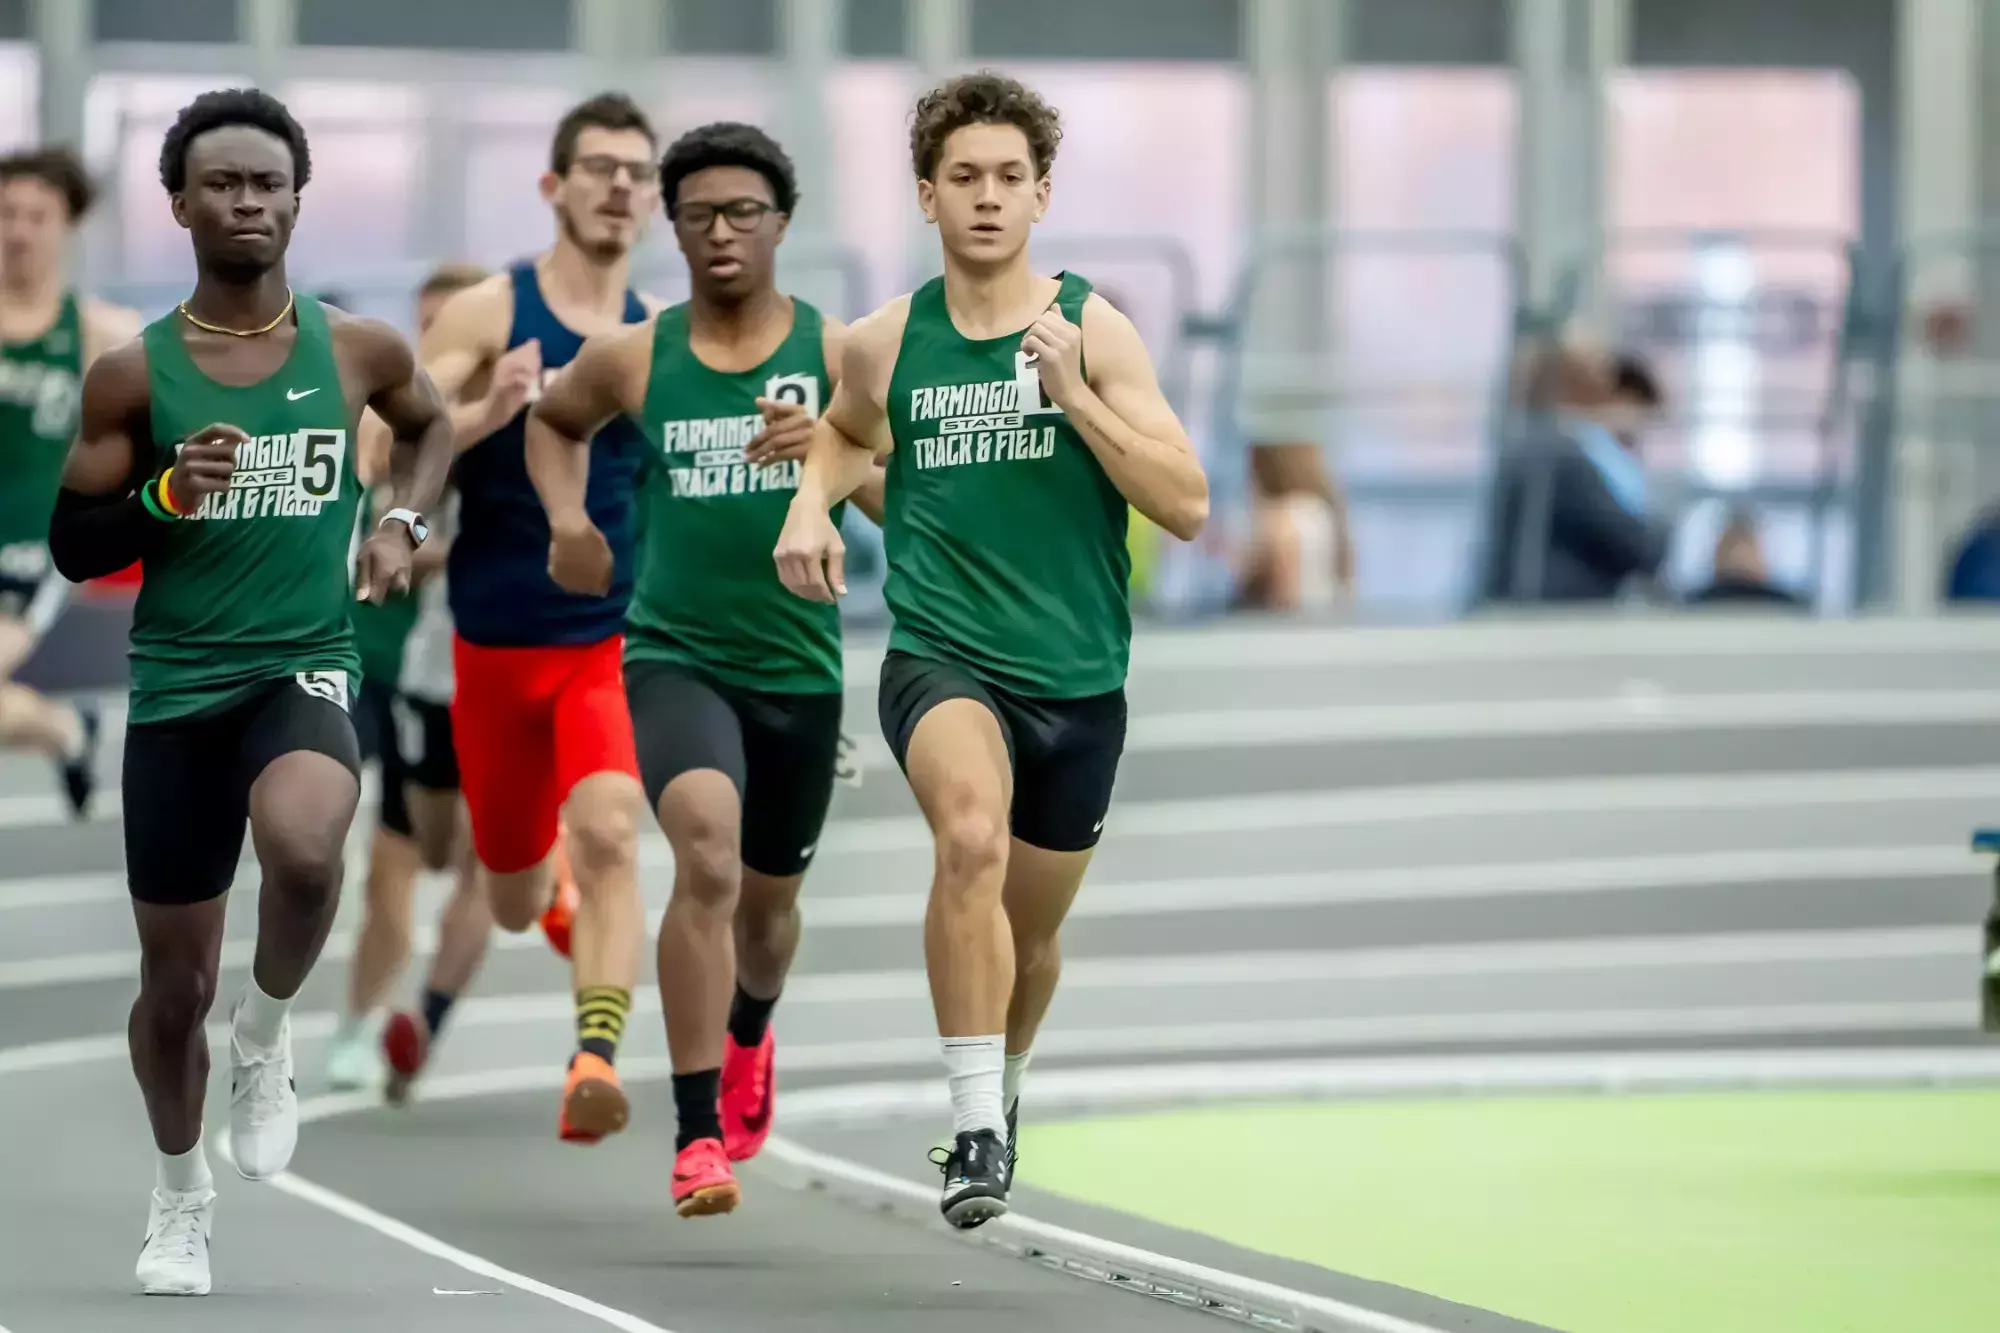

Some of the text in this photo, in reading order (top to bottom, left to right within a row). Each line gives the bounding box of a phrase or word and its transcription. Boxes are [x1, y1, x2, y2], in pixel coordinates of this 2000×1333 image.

[911, 380, 1020, 422] FARMINGD
[944, 416, 1018, 431] STATE
[302, 434, 337, 496] 5
[913, 433, 973, 470] TRACK
[994, 426, 1056, 462] FIELD
[230, 471, 288, 485] TATE
[668, 466, 728, 498] TRACK
